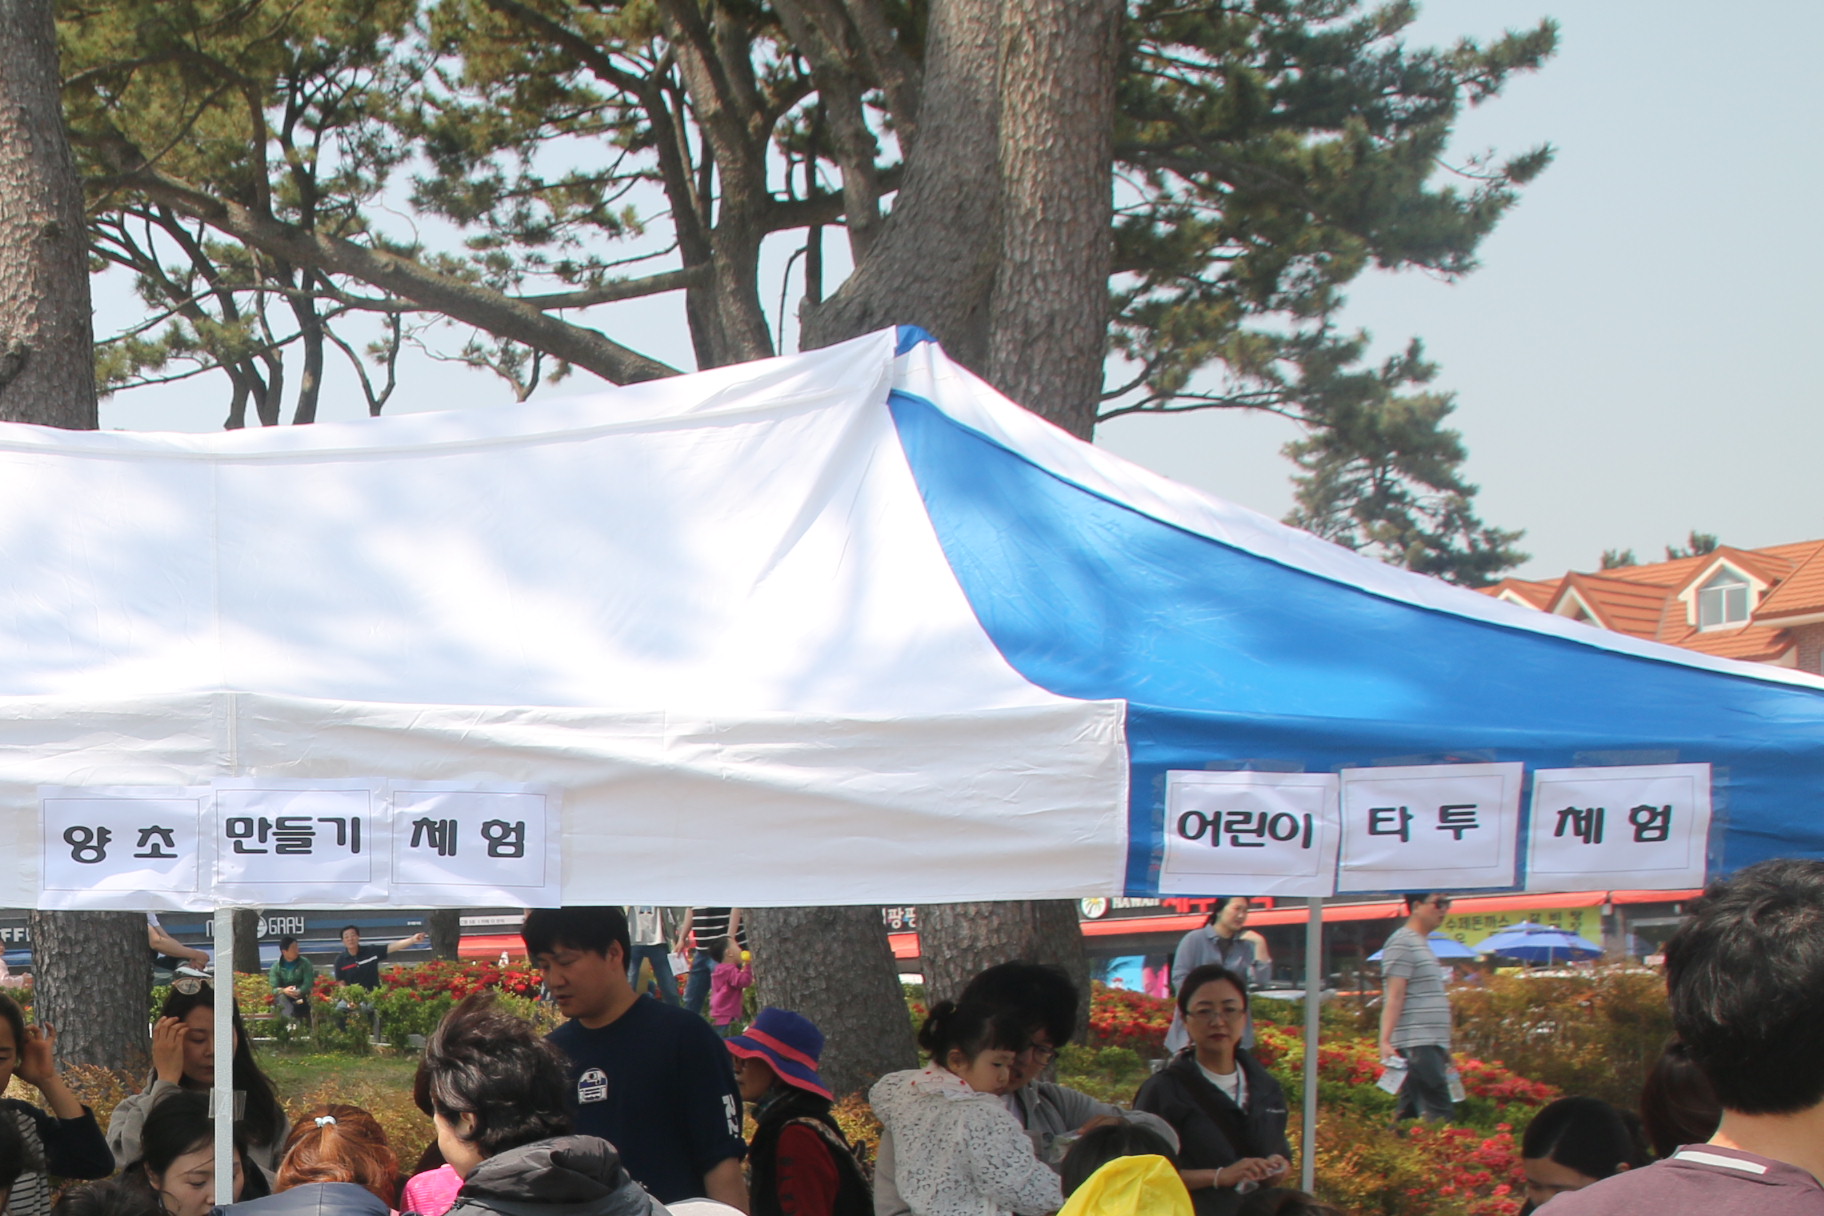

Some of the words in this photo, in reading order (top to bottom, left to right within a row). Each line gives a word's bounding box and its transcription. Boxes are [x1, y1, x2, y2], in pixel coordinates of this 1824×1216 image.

[63, 825, 178, 864] 양초
[226, 817, 361, 855] 만들기
[410, 817, 525, 858] 체험
[1177, 810, 1312, 849] 어린이
[1368, 804, 1479, 843] 타투
[1554, 804, 1672, 844] 체험
[268, 916, 305, 935] GRAY
[1445, 914, 1511, 931] 수제돈까스
